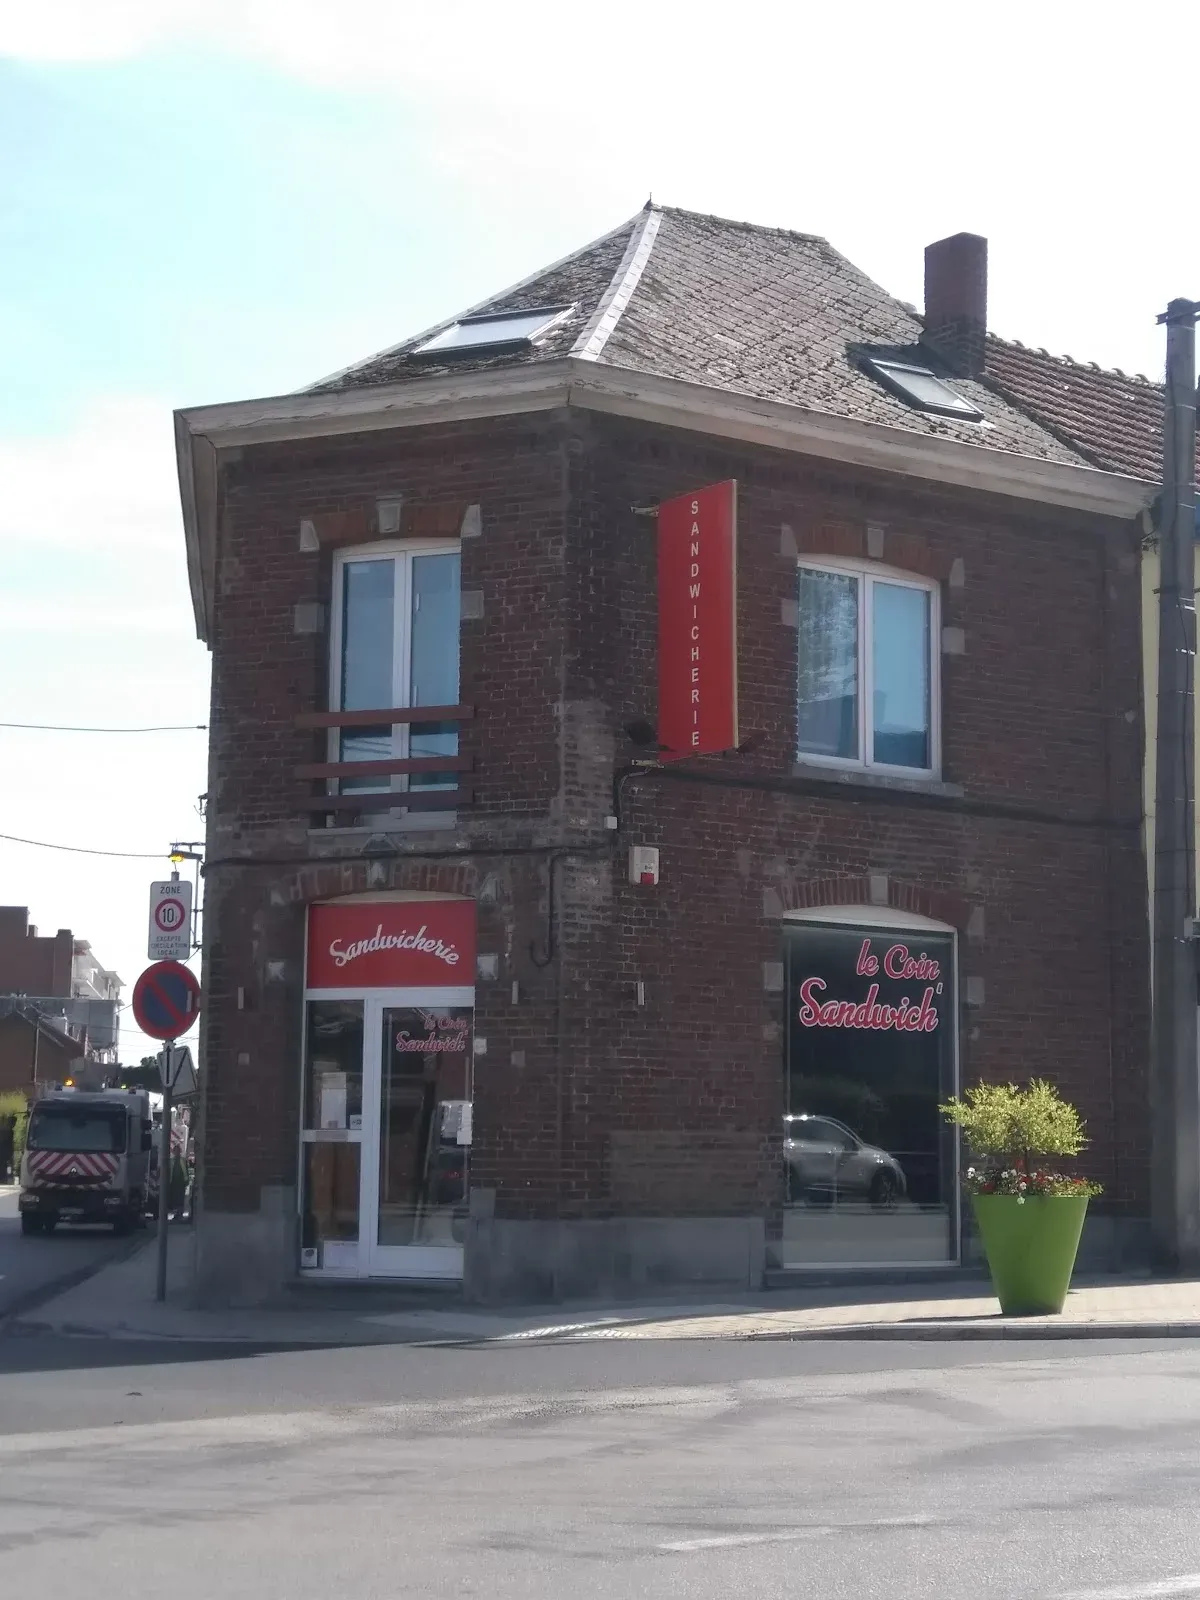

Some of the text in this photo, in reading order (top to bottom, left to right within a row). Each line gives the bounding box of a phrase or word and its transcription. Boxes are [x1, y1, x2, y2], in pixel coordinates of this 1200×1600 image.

[689, 500, 701, 746] SANDWICHERIE
[160, 886, 181, 894] ZONE
[329, 923, 460, 967] Sandwicherie
[856, 938, 940, 981] le Coin
[438, 1016, 468, 1031] Coin
